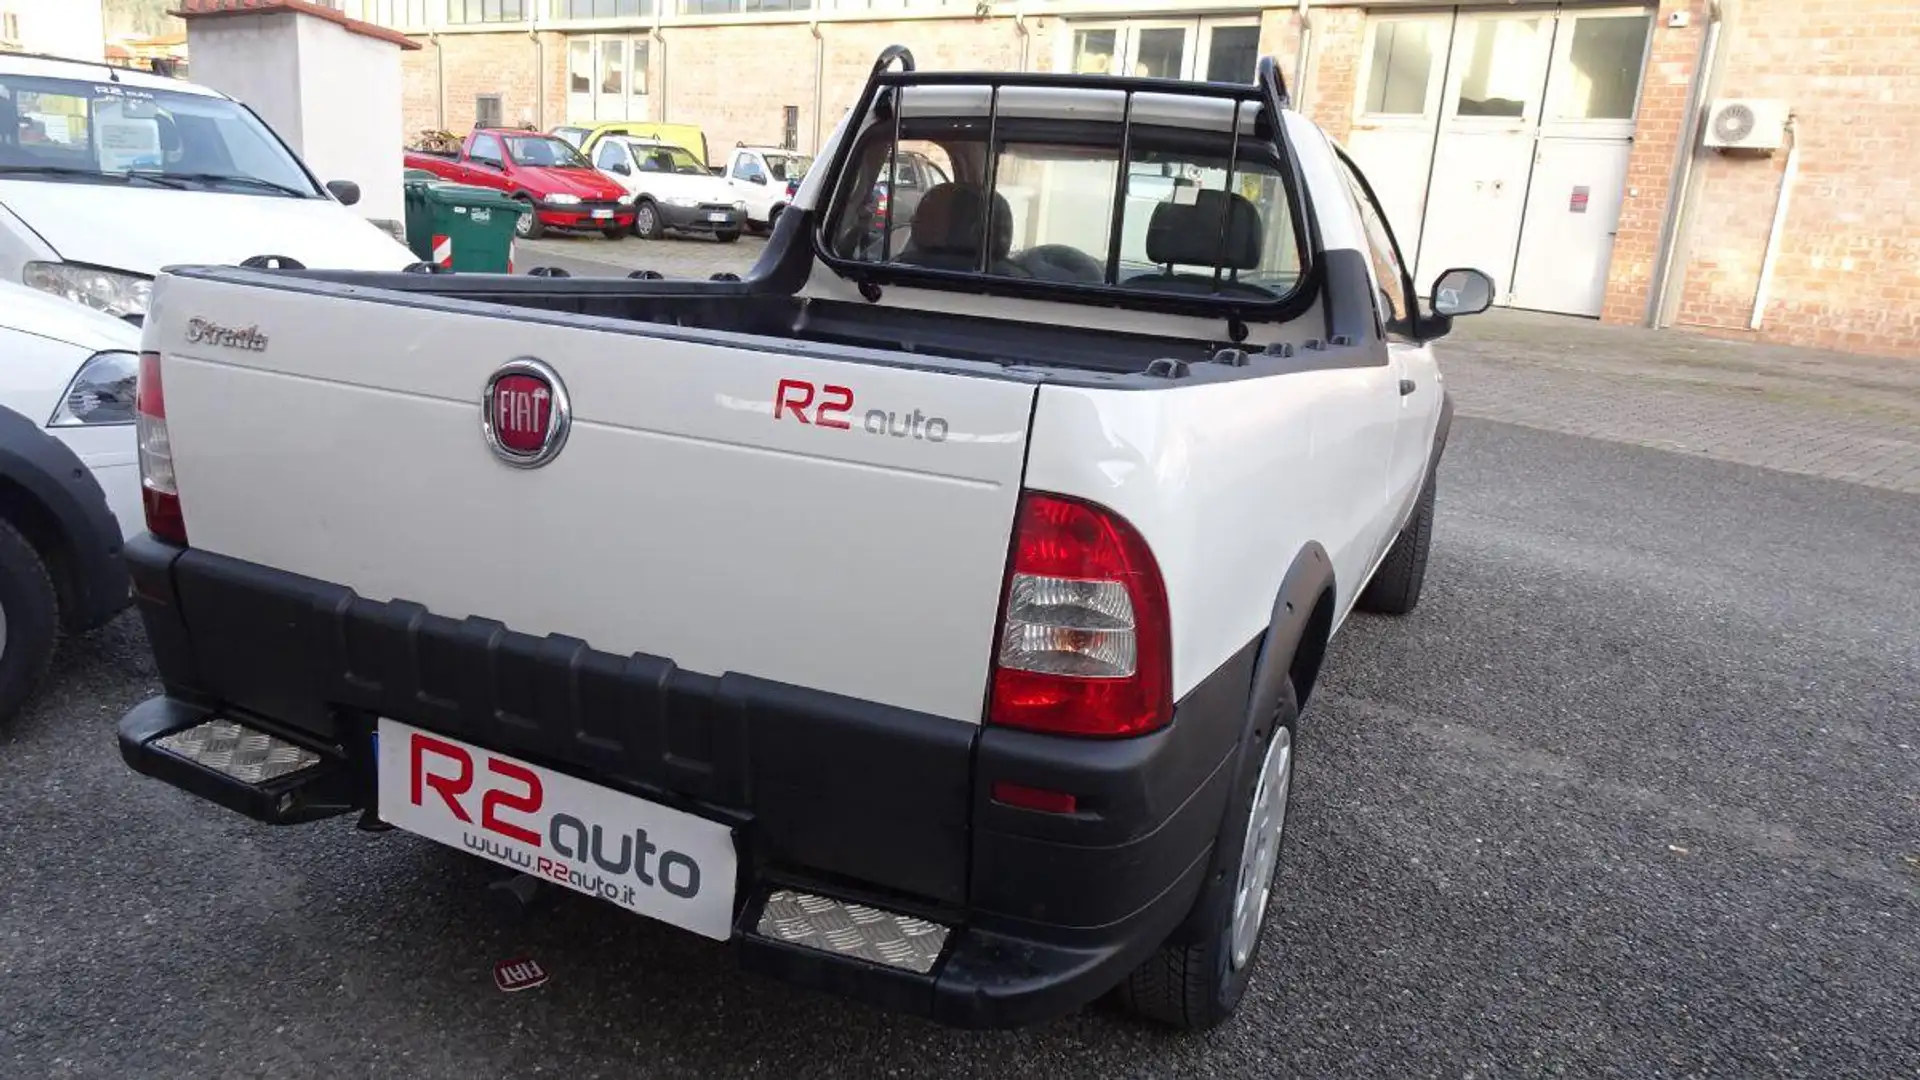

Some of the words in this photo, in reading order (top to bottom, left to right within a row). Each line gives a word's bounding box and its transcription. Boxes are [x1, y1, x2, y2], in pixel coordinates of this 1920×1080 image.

[185, 316, 269, 352] Strada
[500, 388, 549, 433] FIAT
[463, 831, 637, 907] www.R2auto.it
[500, 959, 544, 986] FIAT
